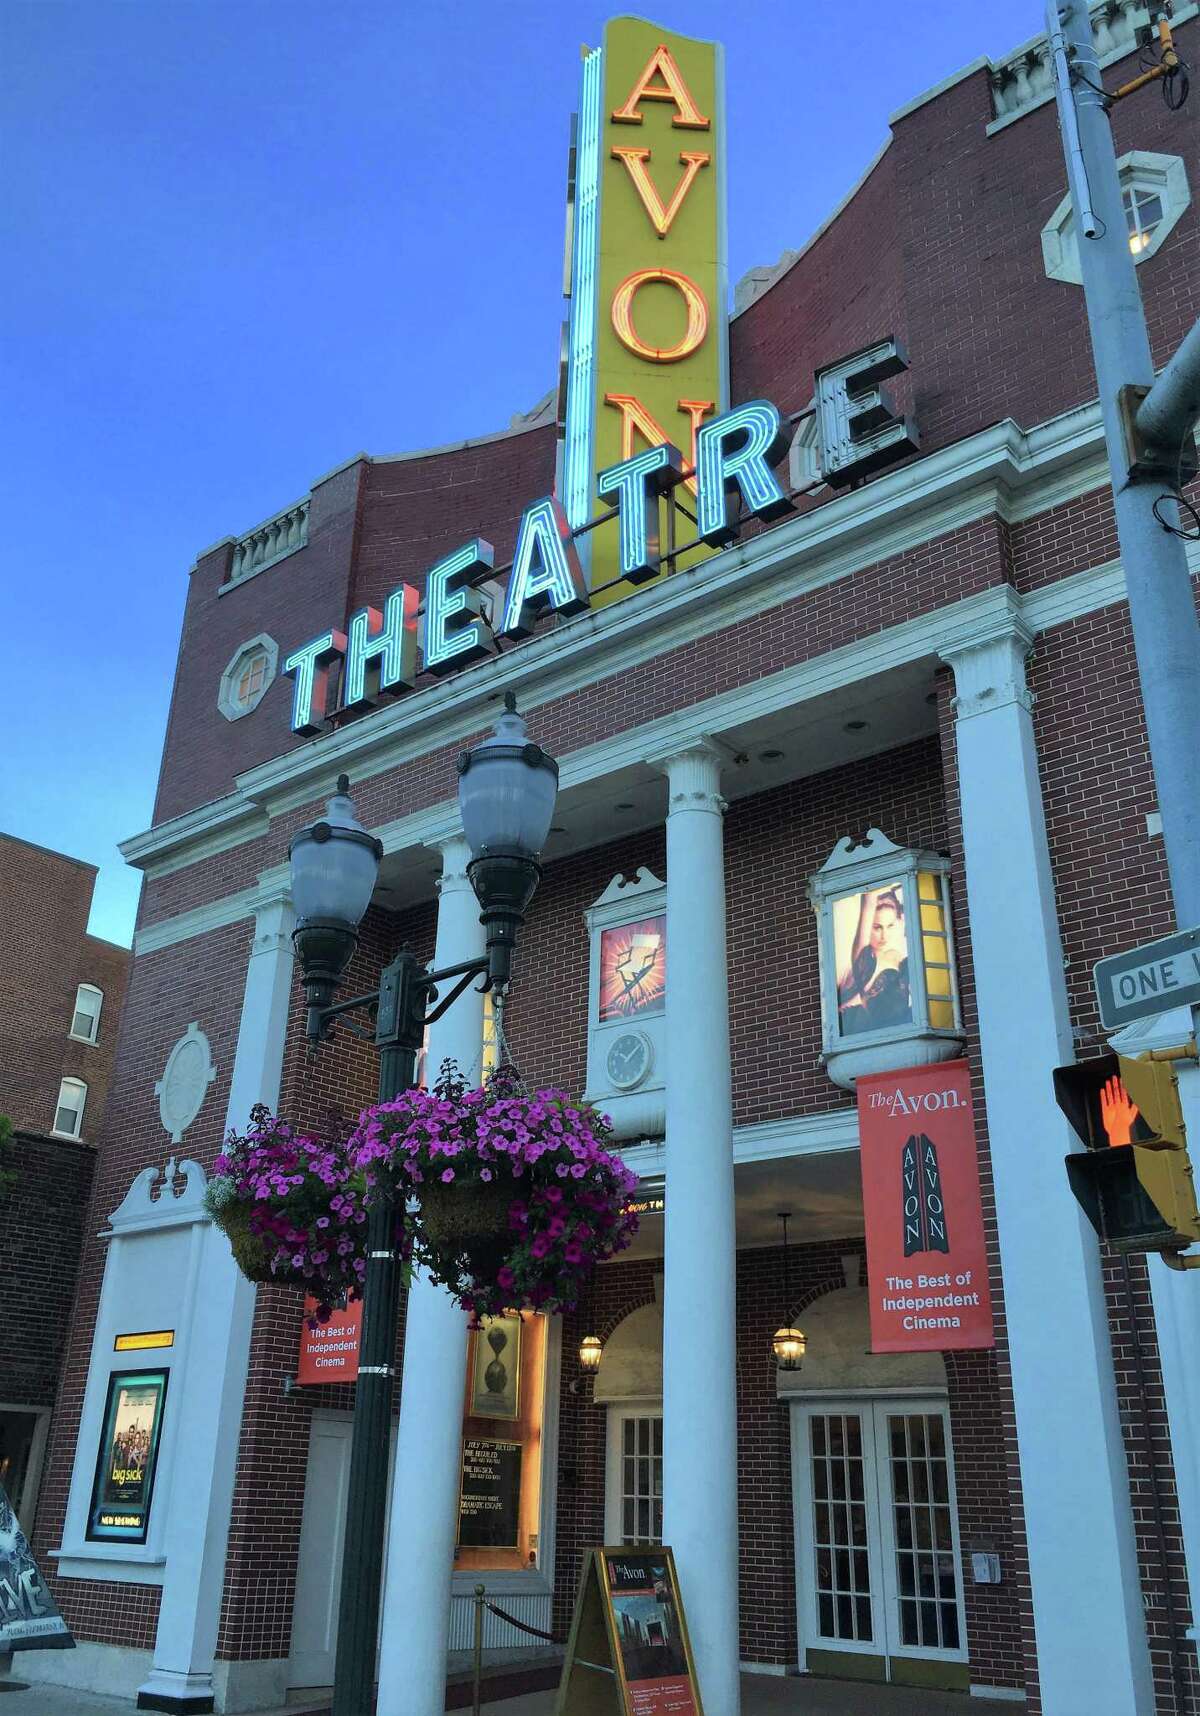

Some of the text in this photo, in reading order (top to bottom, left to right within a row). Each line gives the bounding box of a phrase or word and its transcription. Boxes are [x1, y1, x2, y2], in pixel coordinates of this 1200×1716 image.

[605, 44, 715, 500] AVON
[284, 336, 912, 734] THEATRE
[1119, 960, 1178, 1000] ONE
[867, 1091, 894, 1108] The
[904, 1147, 920, 1245] AVON
[924, 1146, 945, 1240] AVON
[885, 1270, 972, 1291] The Best of
[882, 1292, 980, 1312] Independent
[311, 1325, 356, 1338] The Best of
[903, 1315, 961, 1330] Cinema
[307, 1341, 357, 1353] Independent
[315, 1358, 345, 1367] Cinema
